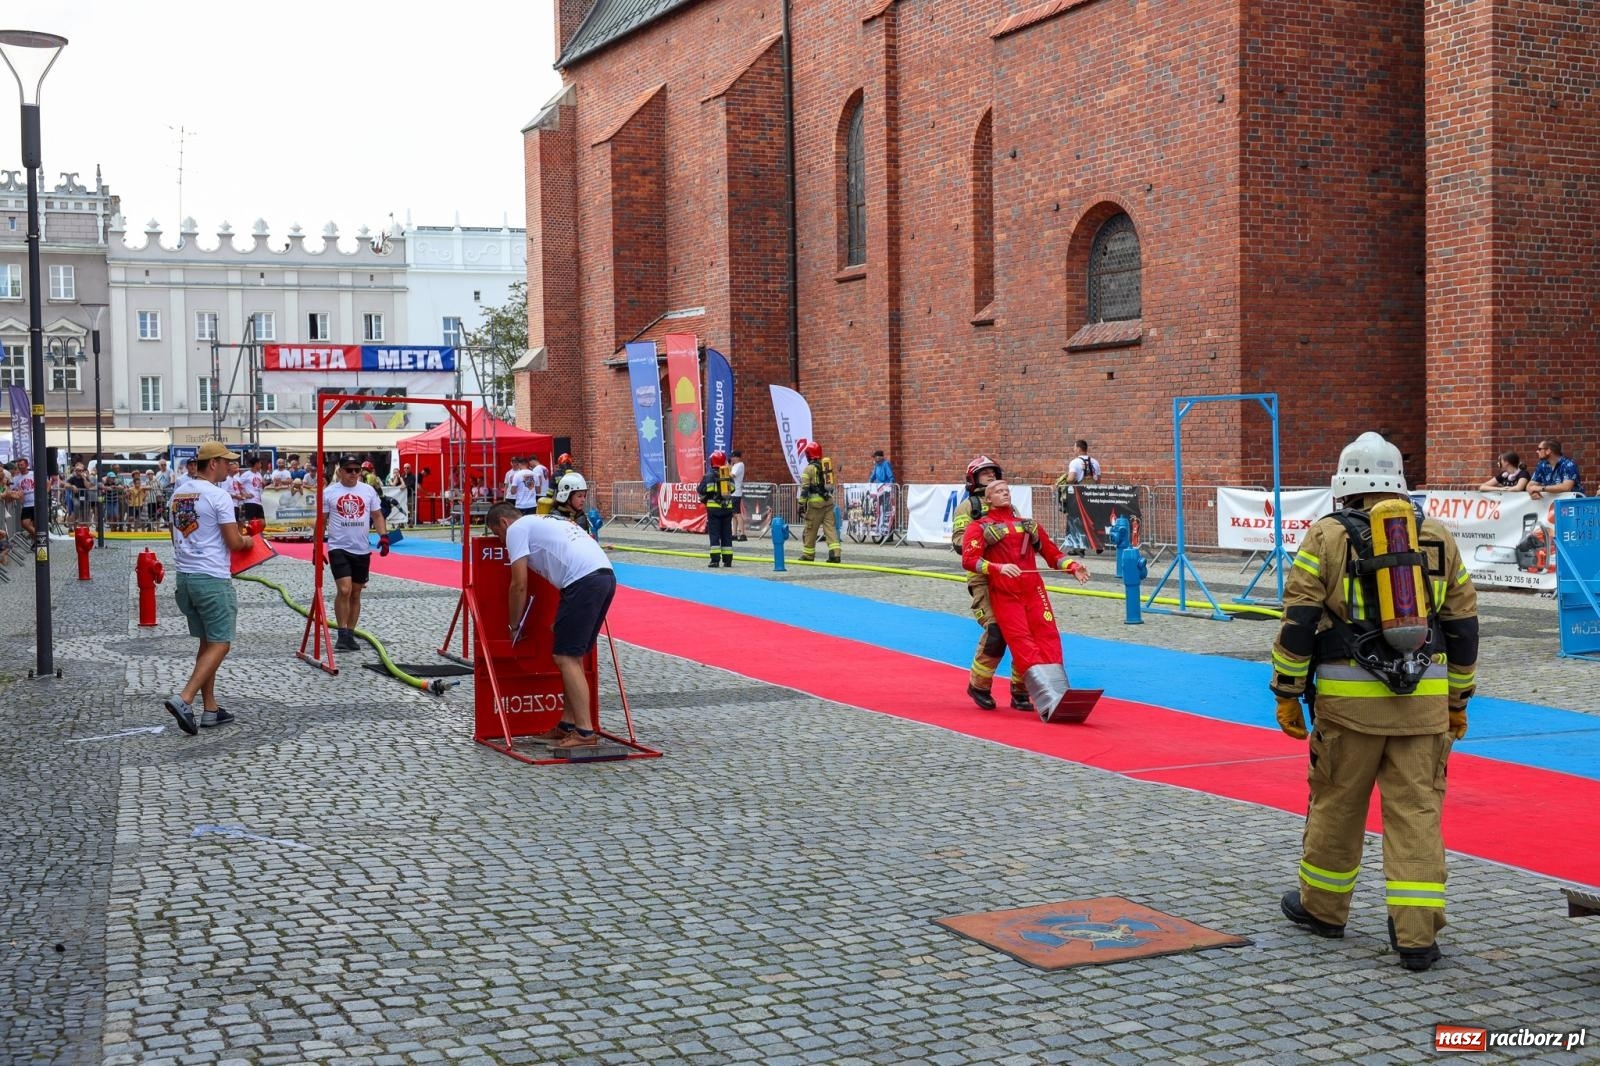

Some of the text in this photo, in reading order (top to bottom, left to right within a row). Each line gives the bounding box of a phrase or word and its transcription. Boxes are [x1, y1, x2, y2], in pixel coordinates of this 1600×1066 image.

[279, 347, 347, 369] META
[377, 349, 444, 370] META
[1427, 498, 1502, 520] RATY 0%
[1514, 575, 1525, 583] 755
